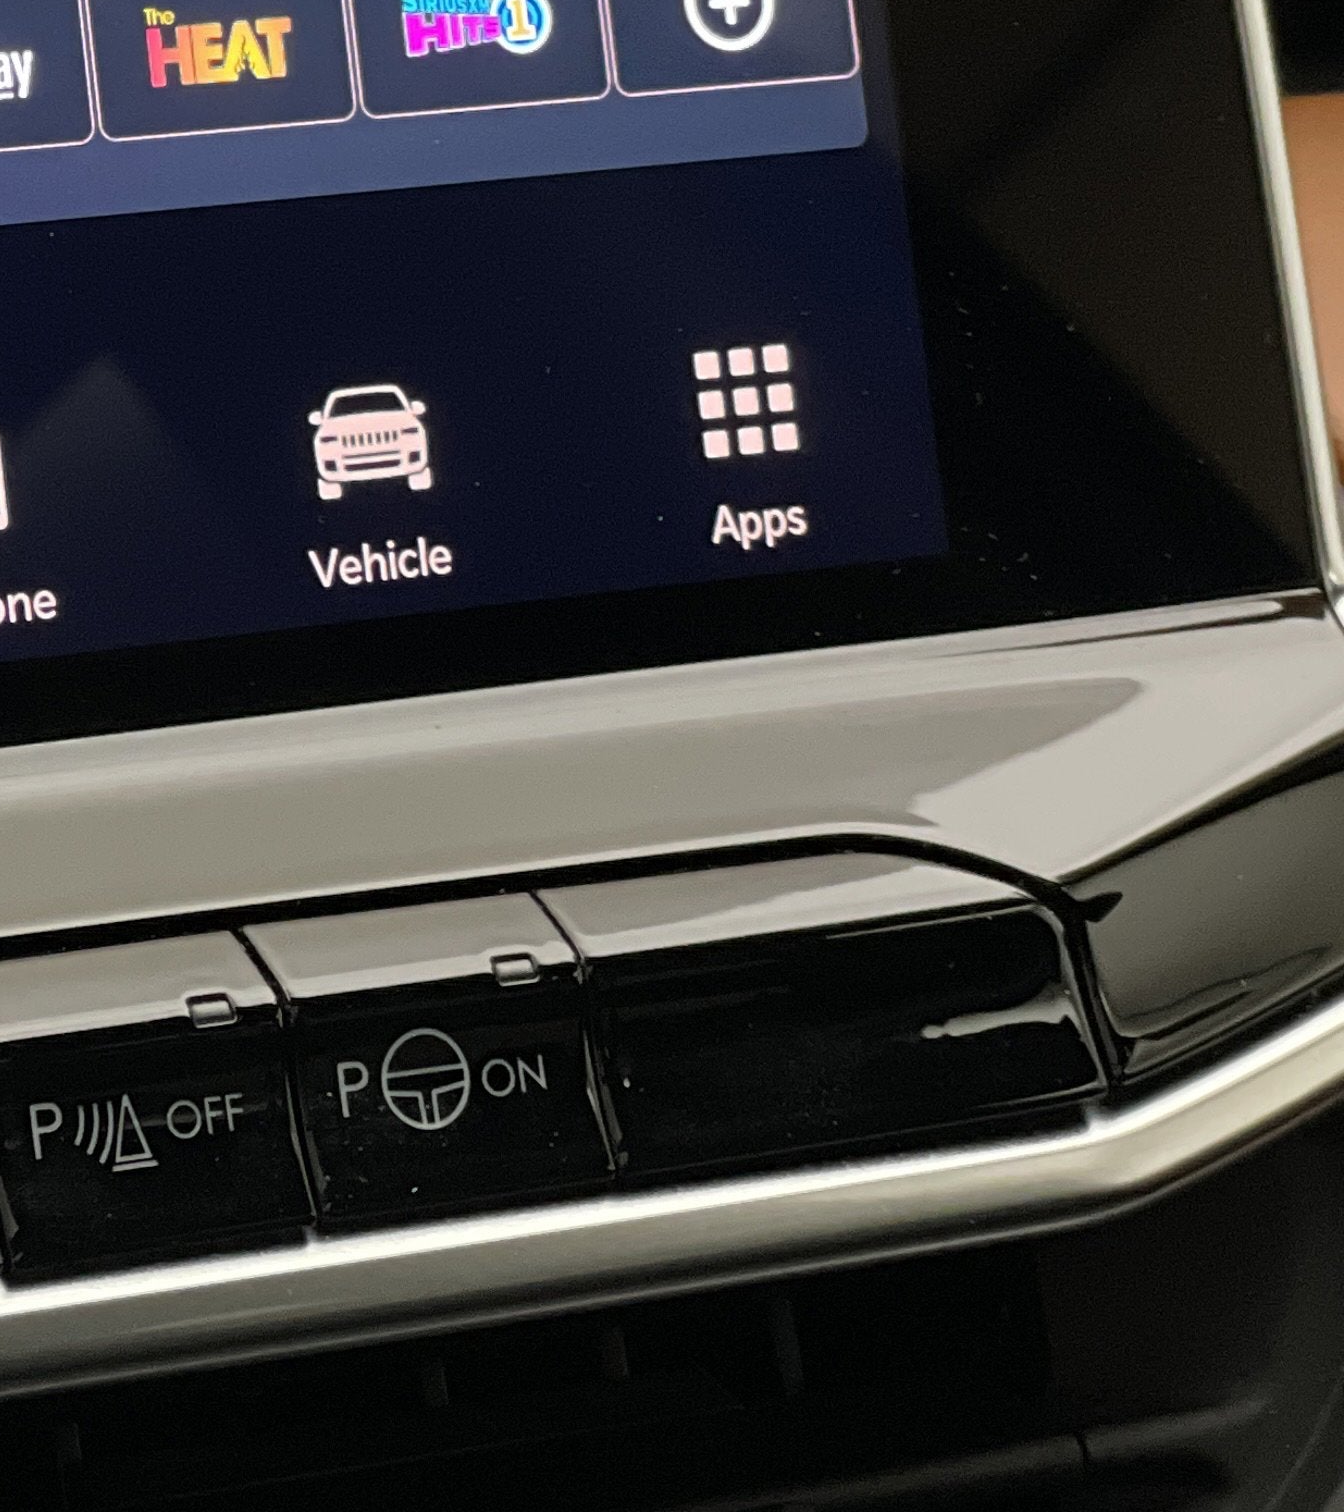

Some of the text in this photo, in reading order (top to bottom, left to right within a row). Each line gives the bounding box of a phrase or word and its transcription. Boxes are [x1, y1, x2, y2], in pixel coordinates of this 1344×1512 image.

[143, 7, 175, 27] The
[403, 12, 501, 57] HITS
[145, 16, 293, 88] HEAT
[713, 500, 808, 550] Apps
[307, 534, 454, 592] Vehicle
[336, 1055, 548, 1118] P ON
[28, 1093, 245, 1161] P OFF
